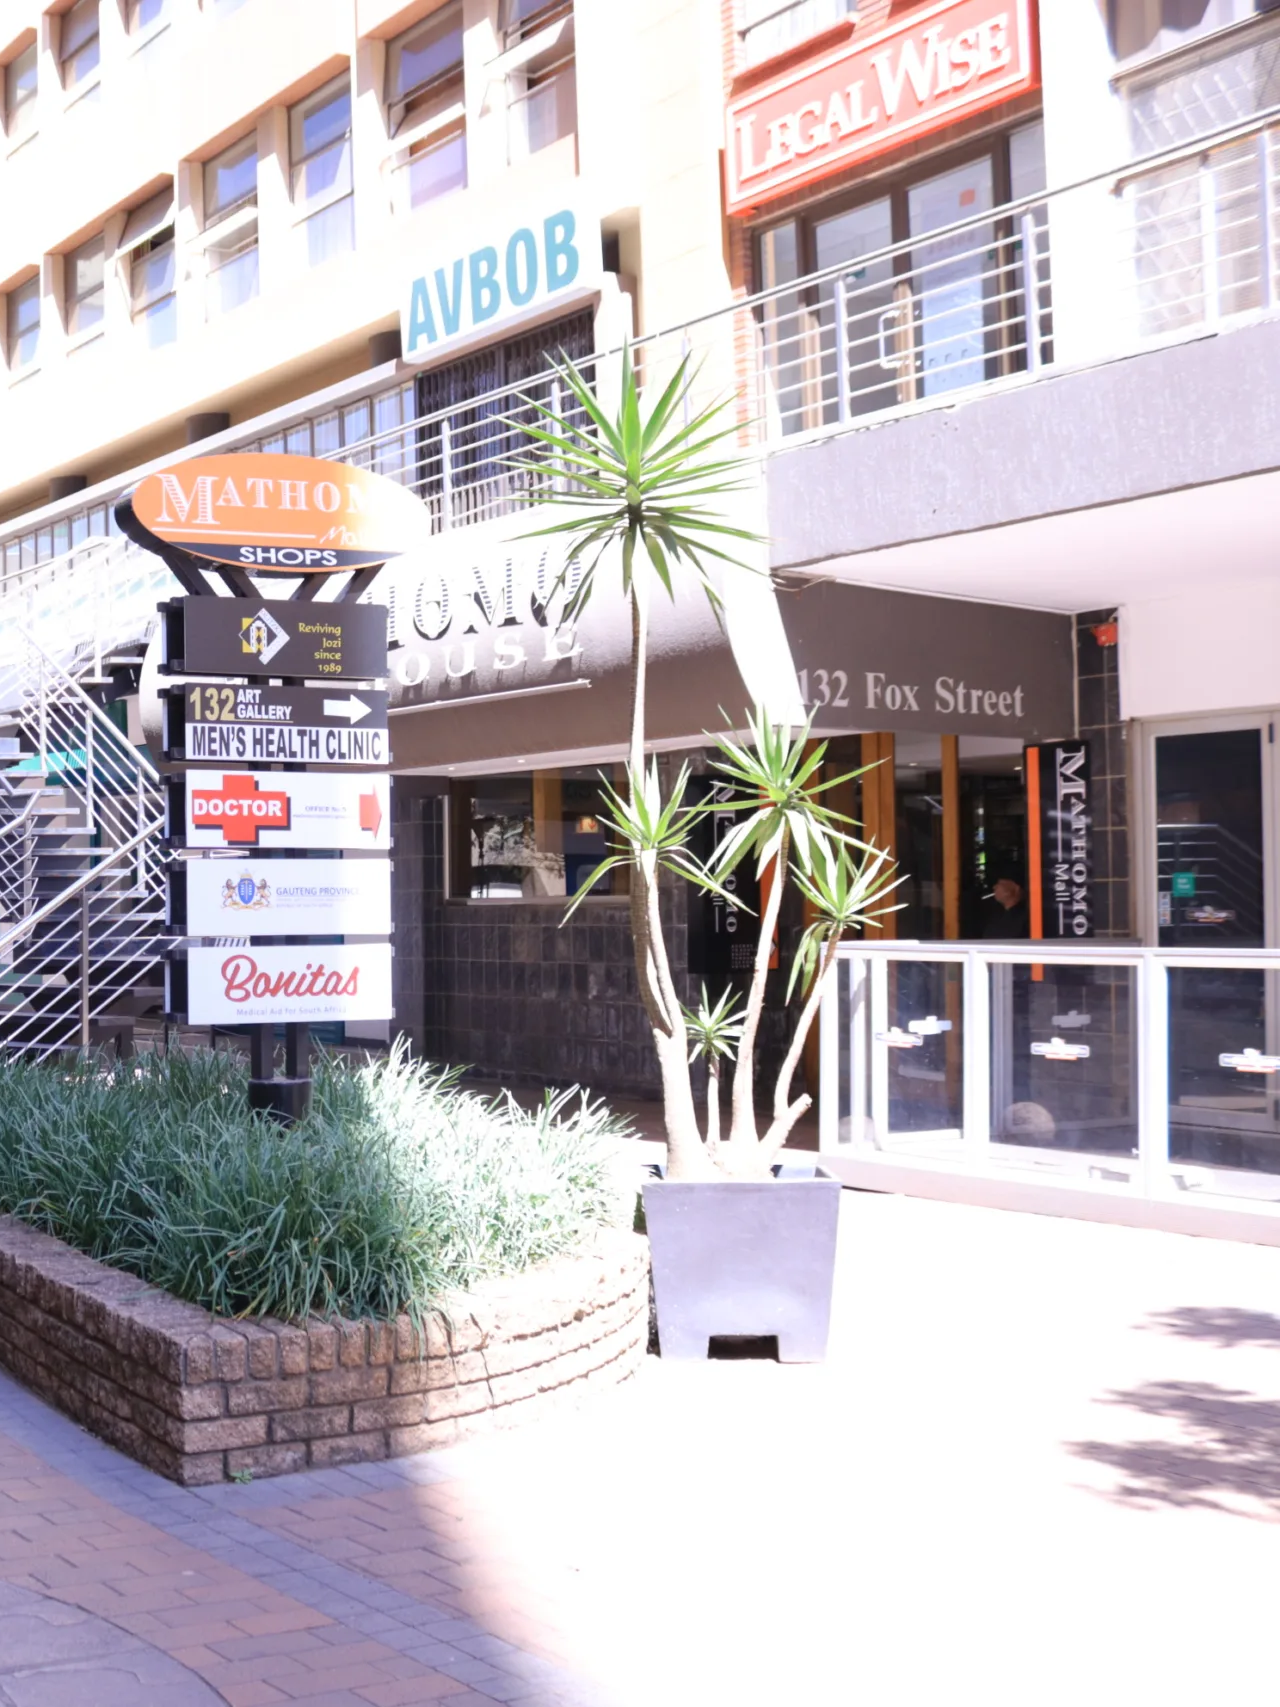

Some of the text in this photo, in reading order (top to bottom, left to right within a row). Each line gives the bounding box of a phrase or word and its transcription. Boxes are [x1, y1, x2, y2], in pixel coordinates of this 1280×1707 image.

[406, 208, 580, 353] AVBOB
[238, 547, 338, 566] SHOPS
[298, 622, 342, 637] Reviving
[322, 637, 342, 650] Jozi
[314, 650, 342, 661] since
[317, 663, 342, 674] 1989
[236, 689, 261, 703] ART
[796, 667, 1025, 718] 132 Fox Street
[189, 686, 235, 721] 132
[236, 704, 292, 721] GALLERY
[191, 726, 382, 760] MEN'S HEALTH CLINIC
[193, 798, 282, 817] DOCTOR
[1061, 745, 1088, 936] MATHOMO
[275, 886, 317, 896] GAUTENG
[1053, 862, 1071, 903] Mall
[220, 953, 360, 1003] Bonitas
[236, 1007, 267, 1016] Medical
[269, 1006, 283, 1015] Aid
